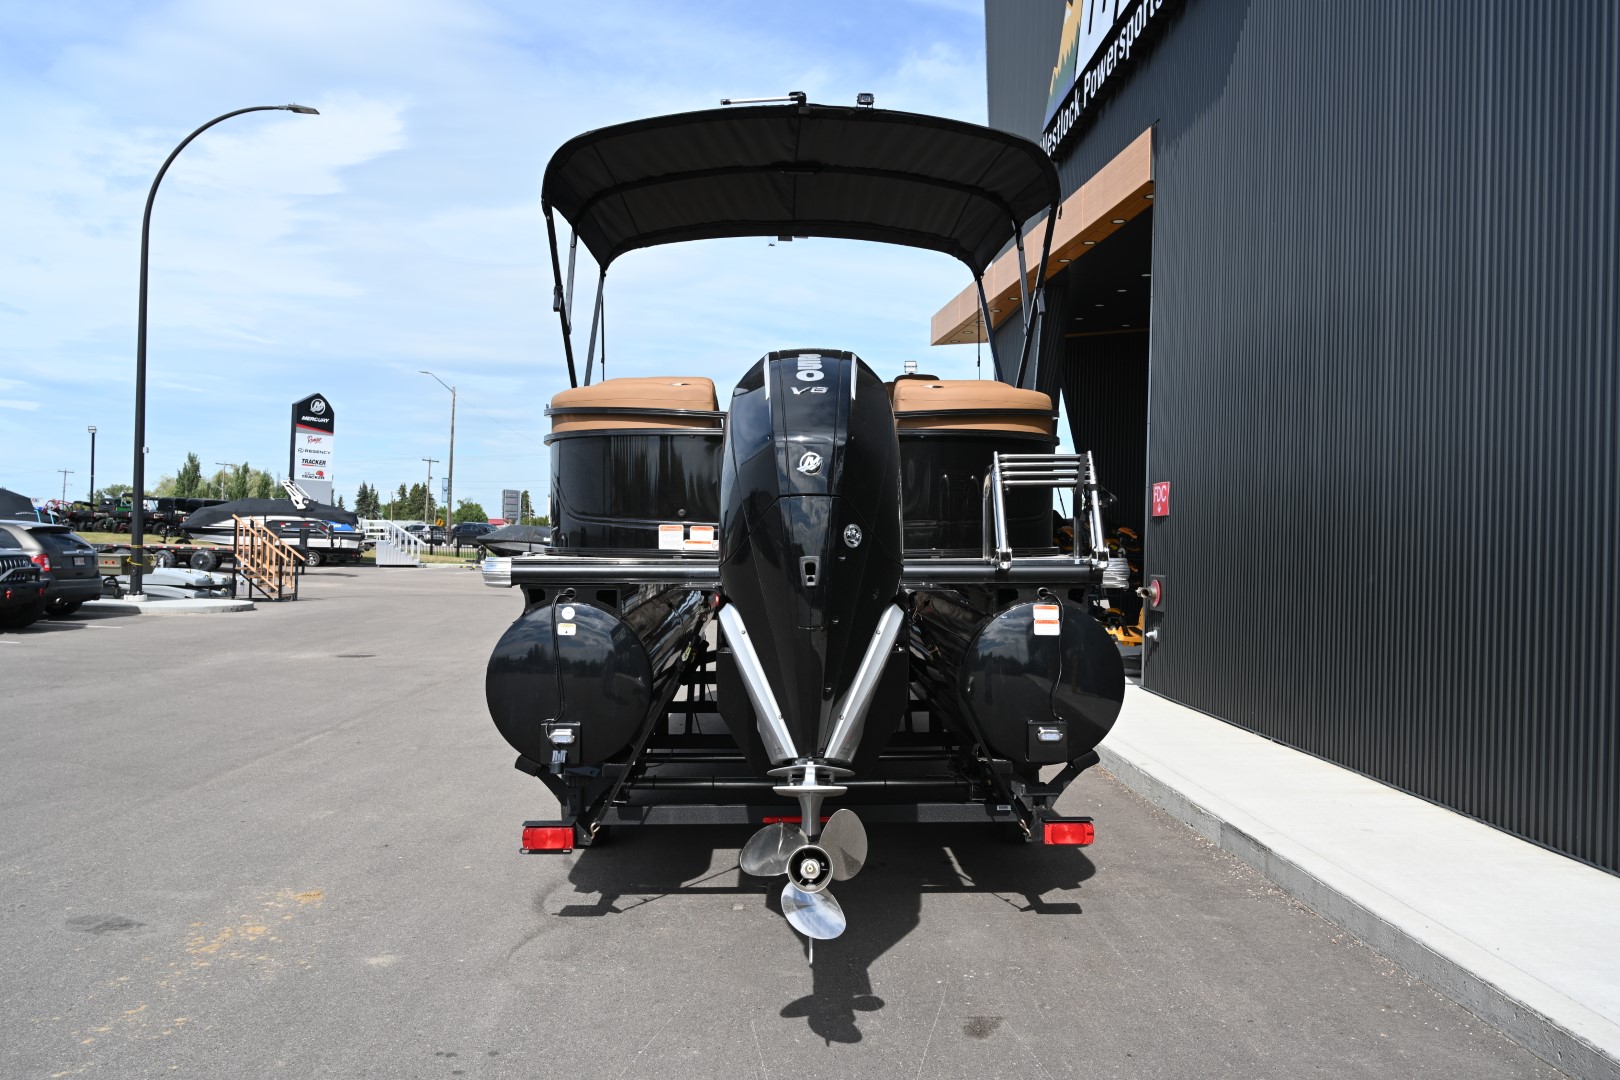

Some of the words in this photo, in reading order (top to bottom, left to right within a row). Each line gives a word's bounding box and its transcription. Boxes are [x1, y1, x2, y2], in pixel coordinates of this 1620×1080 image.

[1083, 0, 1163, 108] Powerspor
[301, 415, 330, 423] MERCURY
[301, 458, 326, 466] TRACKER
[1153, 485, 1167, 503] FDC
